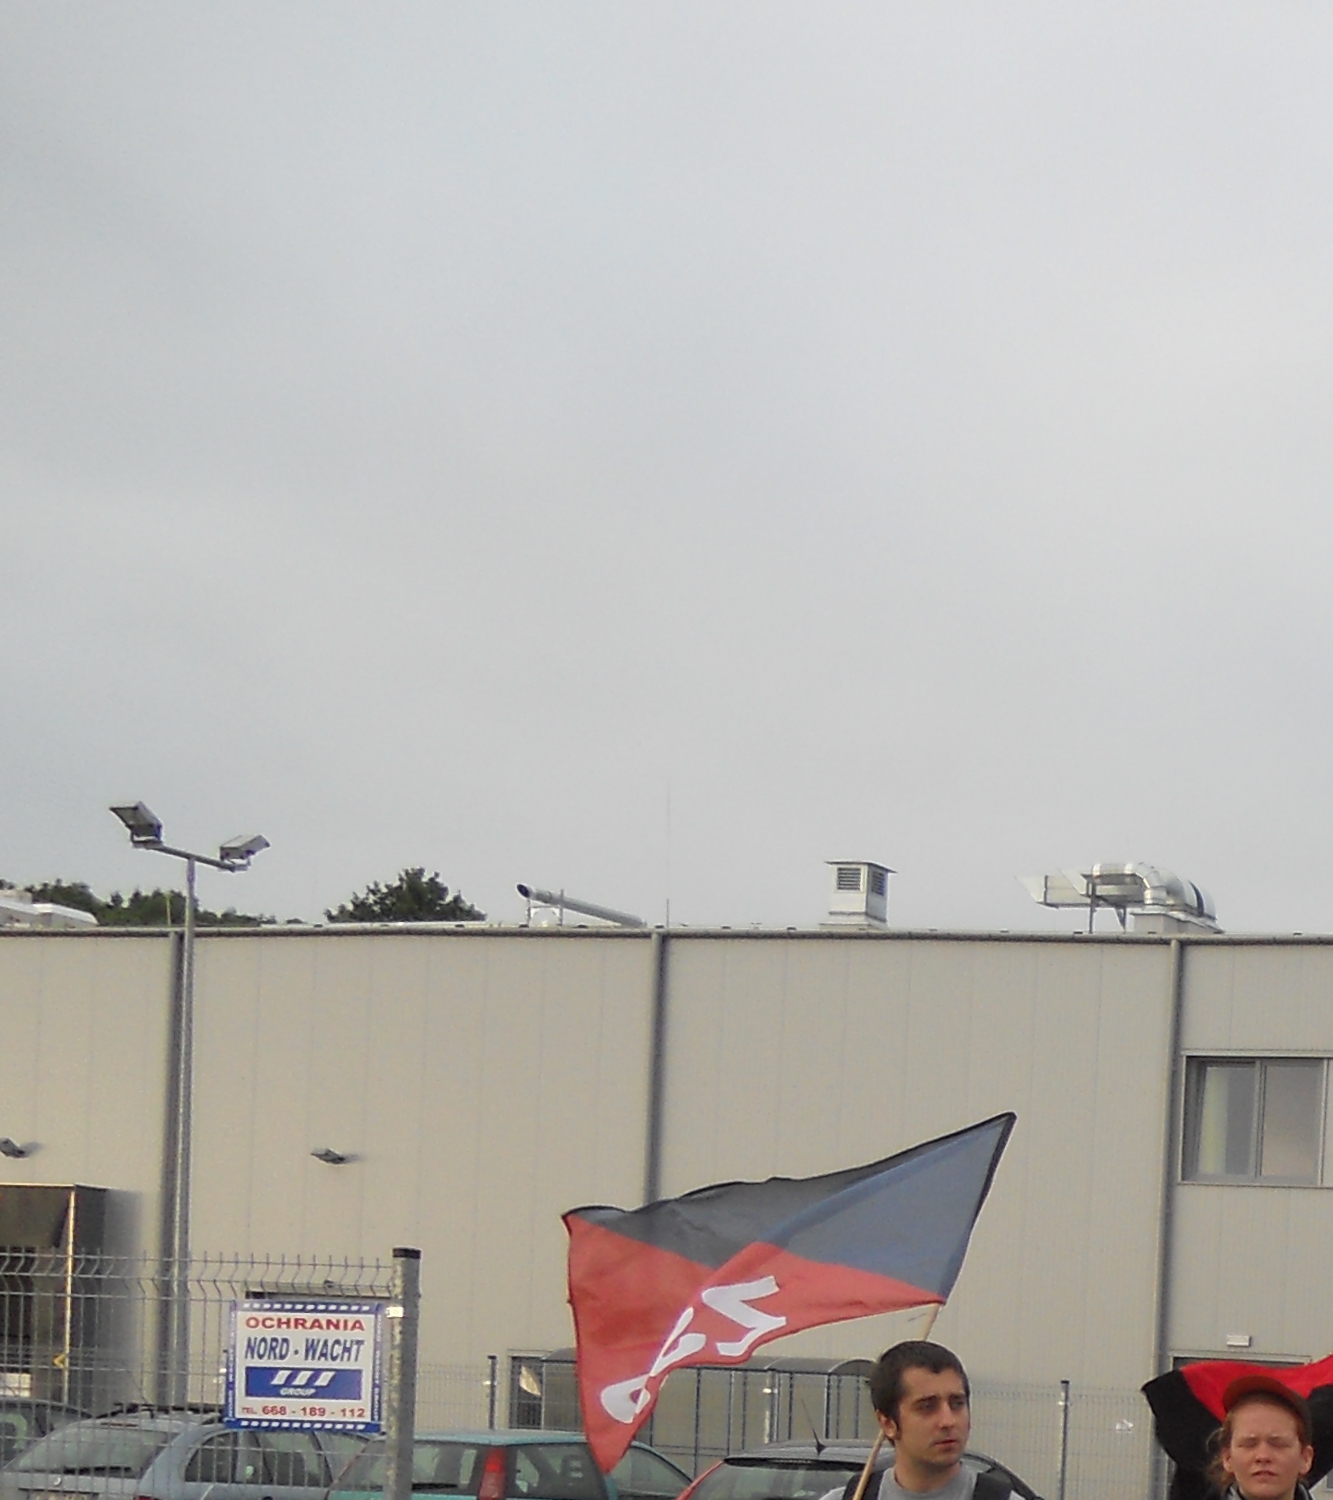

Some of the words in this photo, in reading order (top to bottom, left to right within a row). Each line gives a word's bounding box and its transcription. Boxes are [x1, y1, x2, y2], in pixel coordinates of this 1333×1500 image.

[245, 1316, 366, 1332] OCHRANIA
[244, 1336, 291, 1361] NORD
[303, 1337, 366, 1362] WACHT
[340, 1407, 366, 1418] 112
